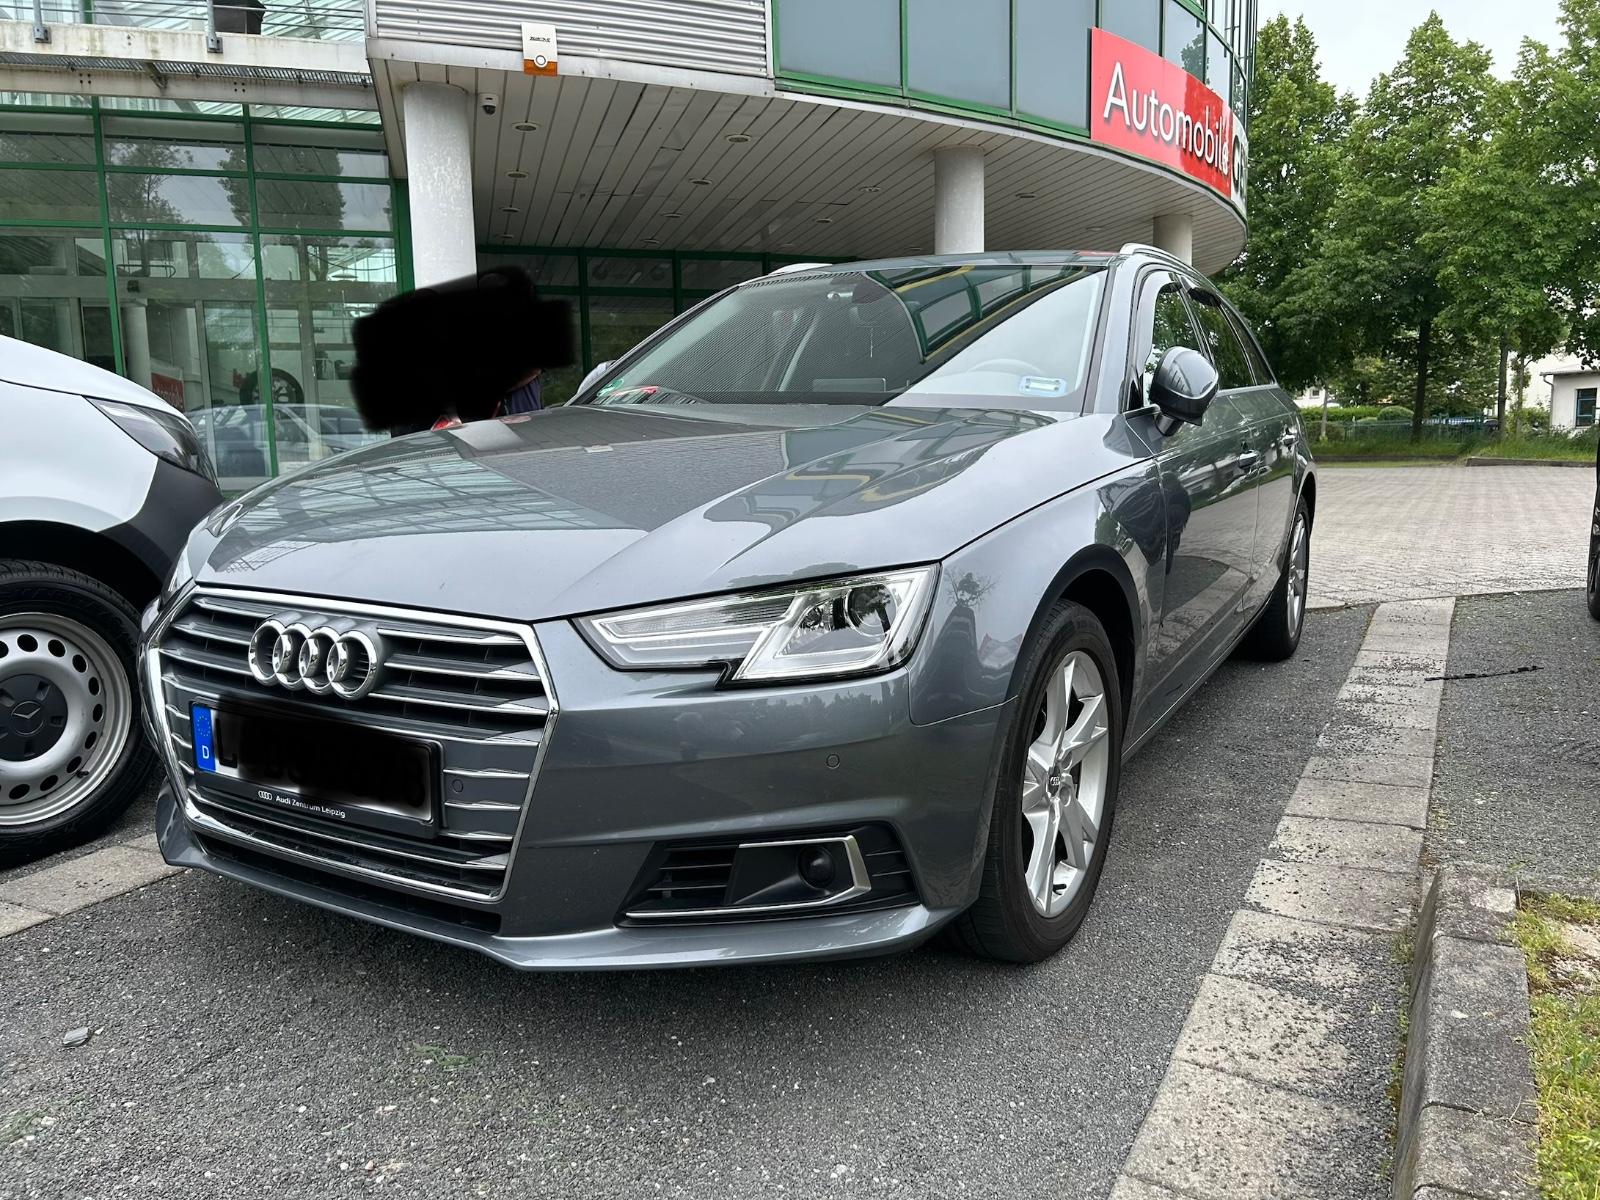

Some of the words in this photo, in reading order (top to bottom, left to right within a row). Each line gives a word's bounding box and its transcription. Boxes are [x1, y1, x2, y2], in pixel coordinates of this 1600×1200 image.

[202, 745, 210, 759] D
[276, 795, 291, 805] Audi
[321, 806, 346, 819] Leipzig
